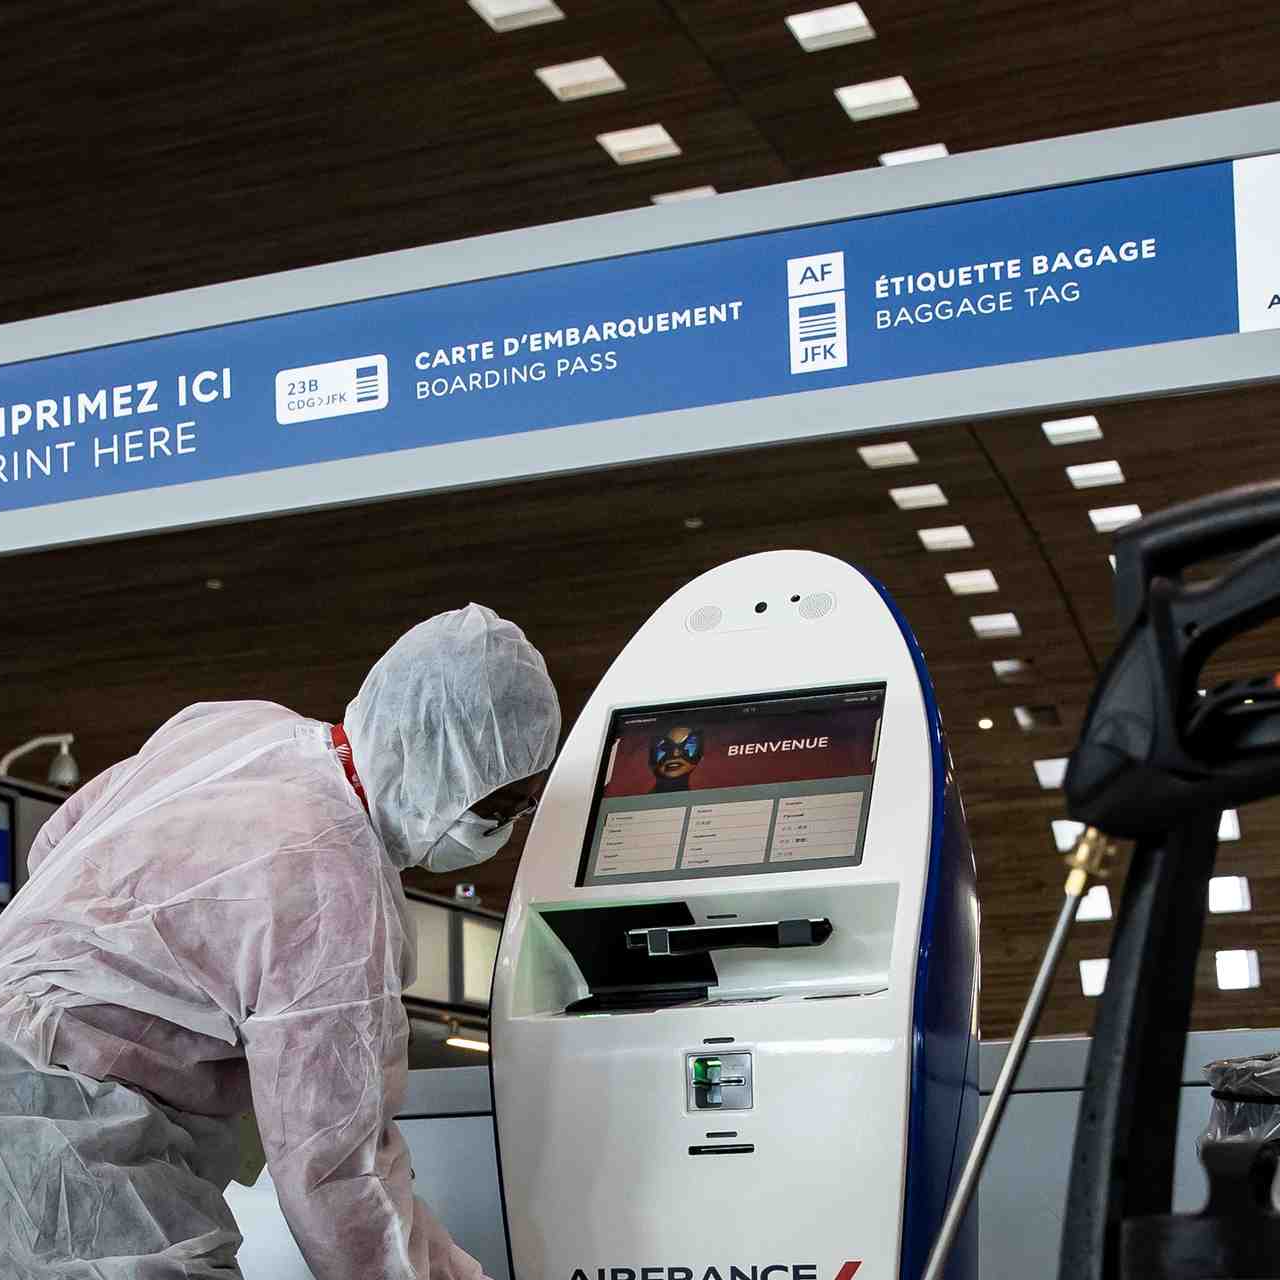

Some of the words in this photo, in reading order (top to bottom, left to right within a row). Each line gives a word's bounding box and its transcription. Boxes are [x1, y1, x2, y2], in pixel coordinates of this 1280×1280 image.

[799, 263, 833, 285] AF
[875, 258, 1022, 299] ÉTIQUETTE
[1032, 238, 1158, 276] BAGAGE
[875, 290, 1012, 330] BAGGAGE
[1023, 281, 1081, 308] TAG
[415, 340, 495, 371] CARTE
[503, 301, 744, 357] D'EMBARQUEMENT
[800, 344, 837, 364] JFK
[177, 367, 232, 408] ICI
[287, 378, 320, 397] 23B
[416, 362, 546, 400] BOARDING
[556, 351, 618, 378] PASS
[93, 421, 198, 469] HERE
[727, 736, 829, 757] BIENVENUE
